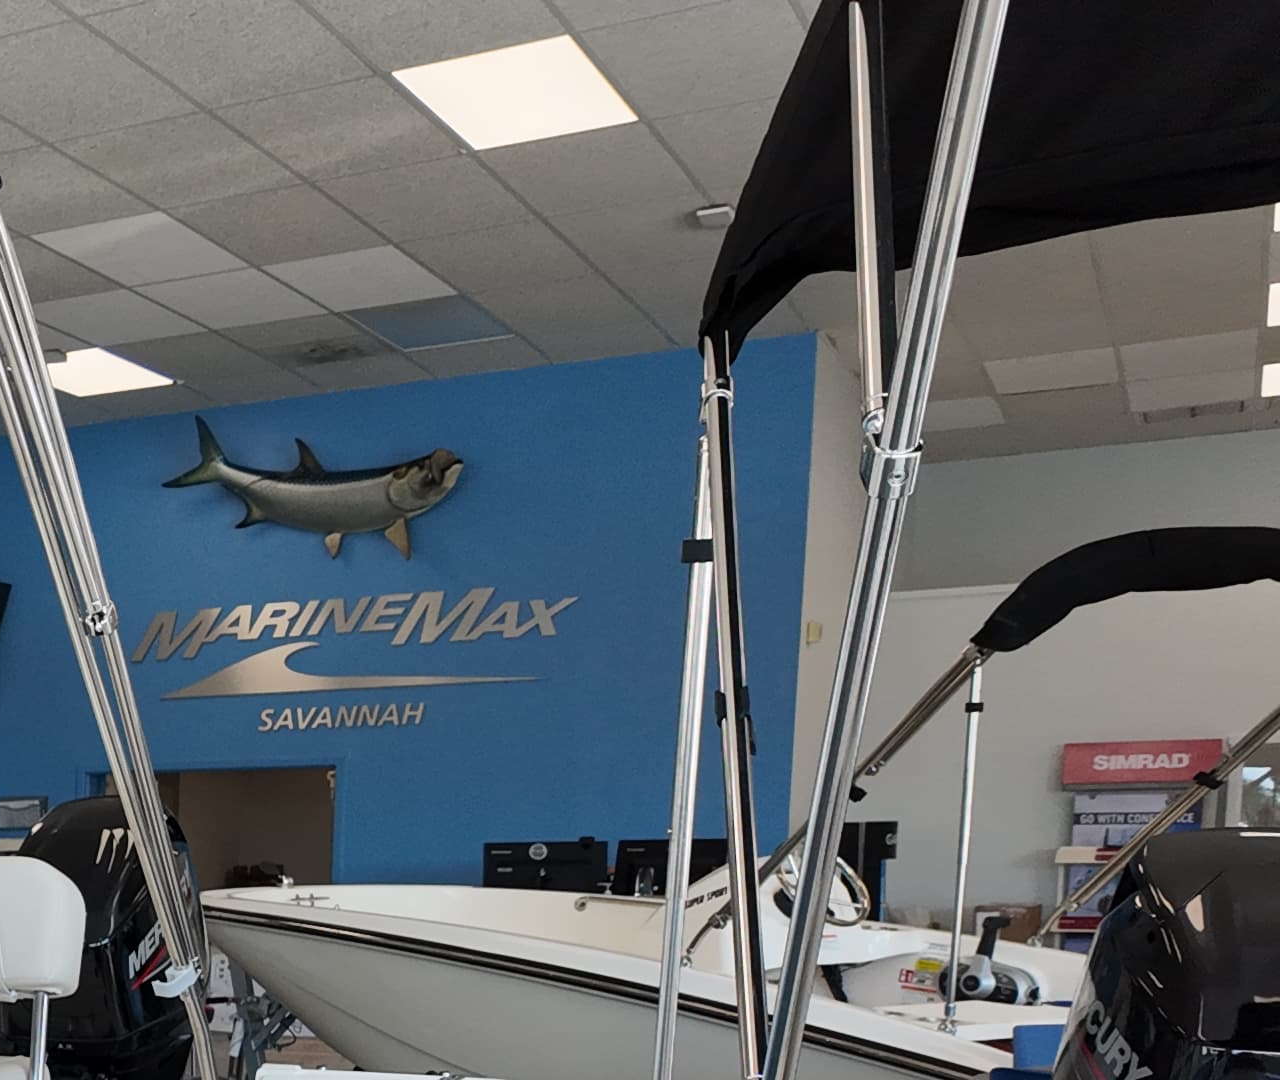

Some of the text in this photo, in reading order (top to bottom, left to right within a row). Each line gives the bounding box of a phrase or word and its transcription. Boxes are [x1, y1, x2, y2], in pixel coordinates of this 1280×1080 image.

[257, 702, 425, 731] SAVANNAH
[1092, 753, 1190, 770] SIMRAD
[1079, 814, 1095, 824] GO
[1096, 813, 1125, 823] WITH
